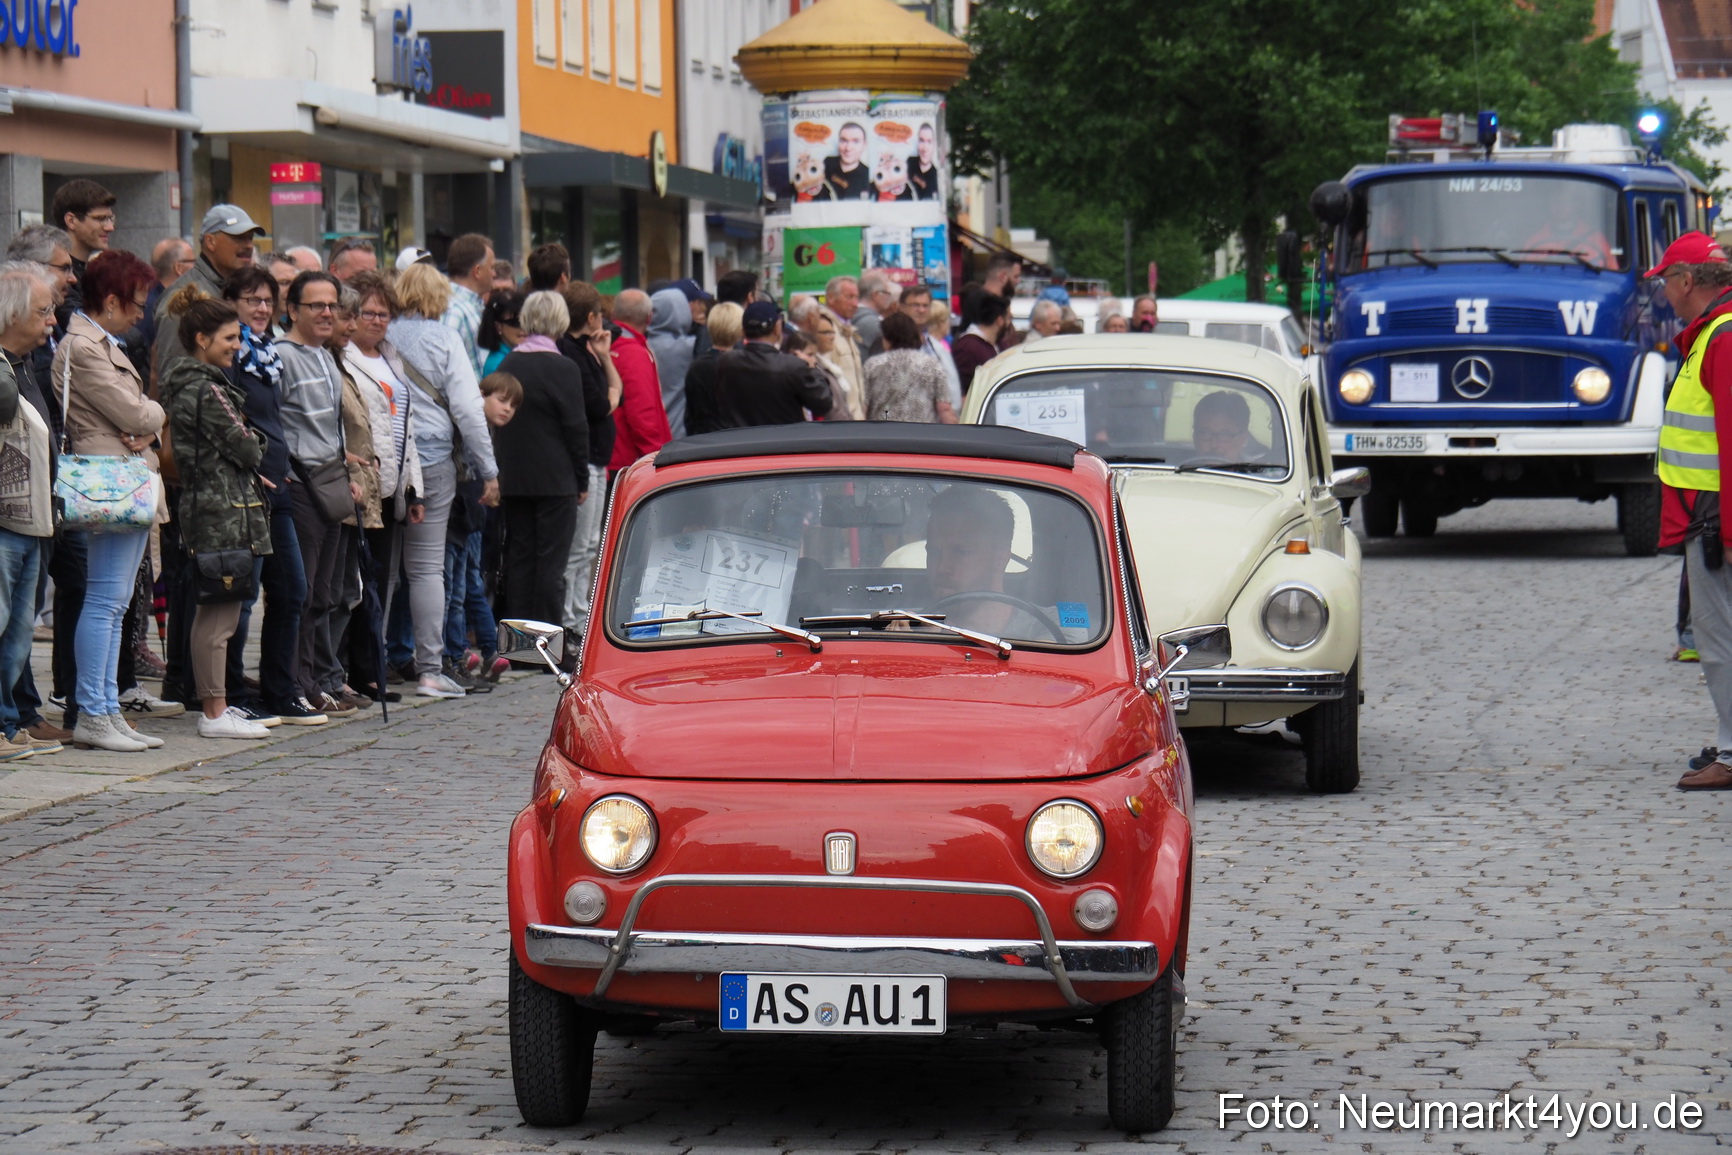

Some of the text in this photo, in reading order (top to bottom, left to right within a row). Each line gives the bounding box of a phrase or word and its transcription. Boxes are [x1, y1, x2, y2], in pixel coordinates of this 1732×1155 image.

[1449, 177, 1523, 192] NM 24/53
[1413, 372, 1429, 381] 511
[1038, 404, 1067, 419] 235
[1354, 436, 1423, 449] THW 82535
[717, 546, 770, 576] 237
[1064, 616, 1086, 625] 2009
[830, 839, 850, 871] FIAT
[753, 982, 809, 1024] AS
[729, 1007, 739, 1020] D
